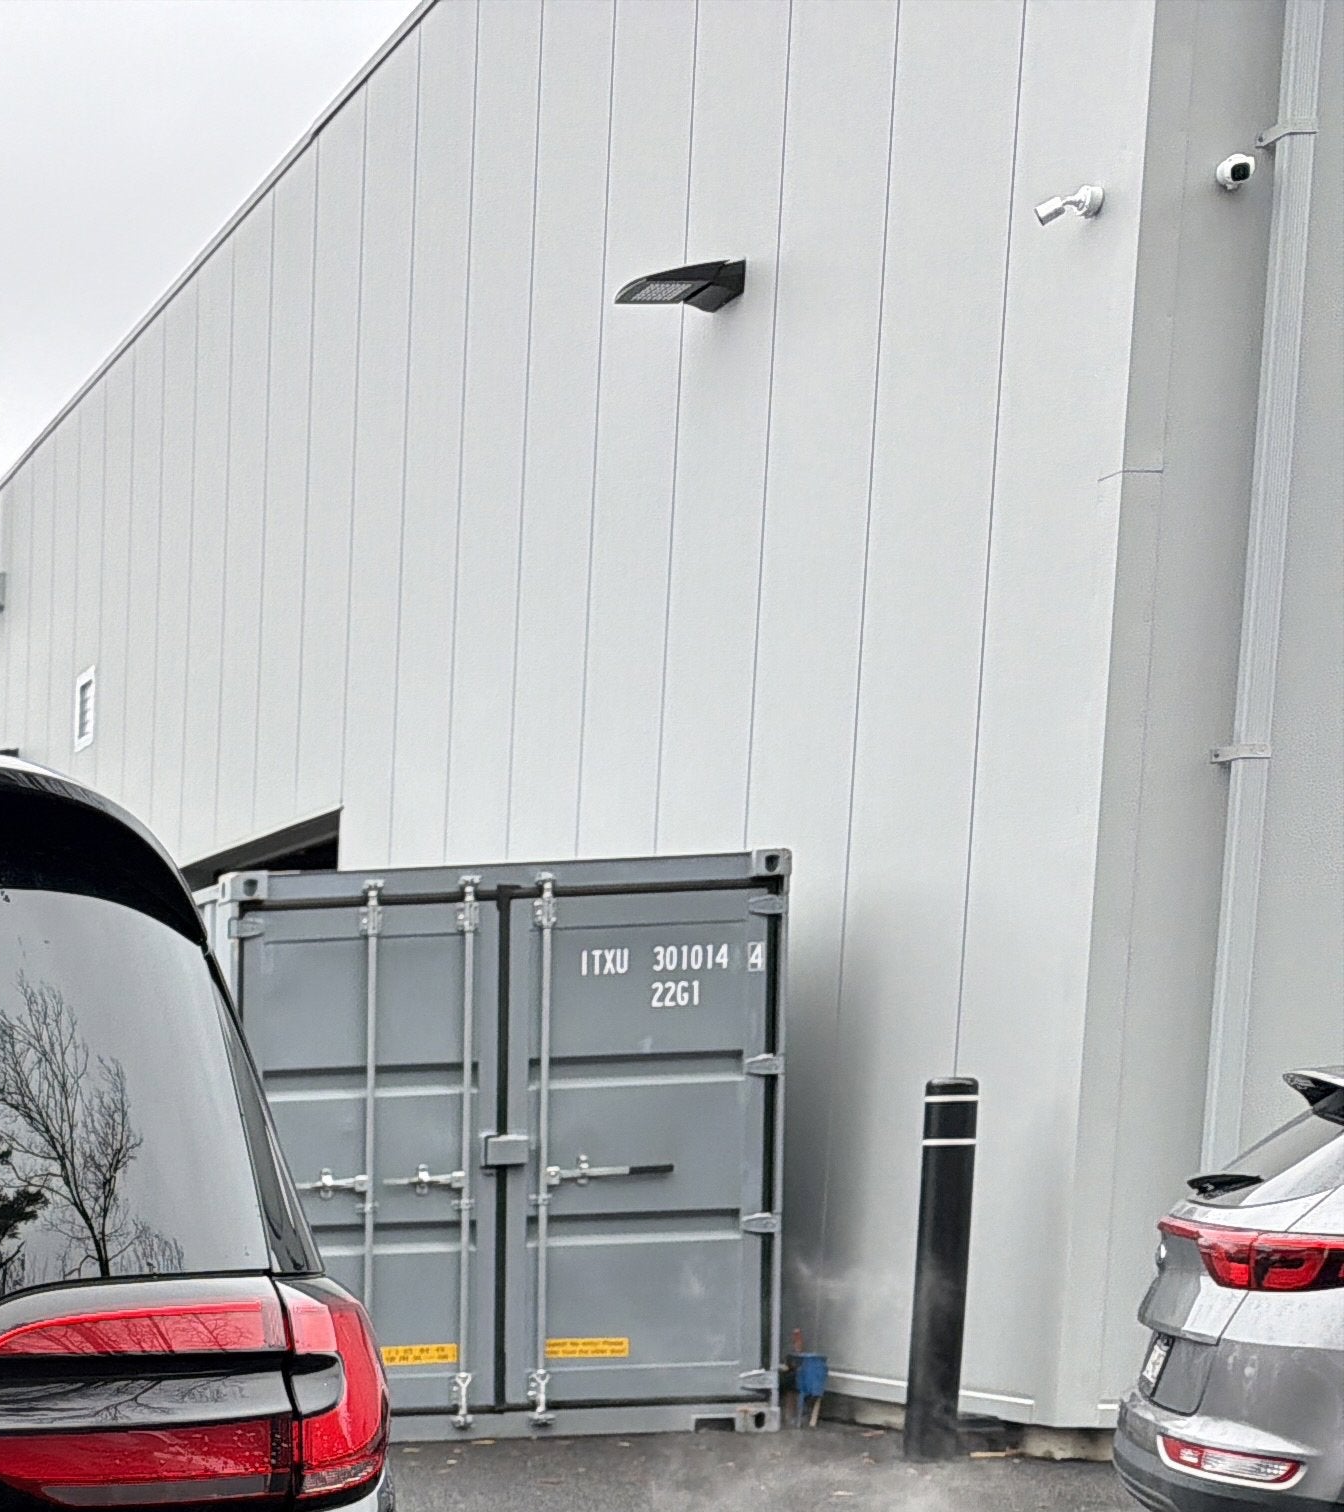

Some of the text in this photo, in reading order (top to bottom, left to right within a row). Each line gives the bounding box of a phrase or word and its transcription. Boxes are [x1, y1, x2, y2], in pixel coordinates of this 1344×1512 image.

[581, 943, 762, 976] ITXU 301014 4
[651, 980, 700, 1008] 22G1
